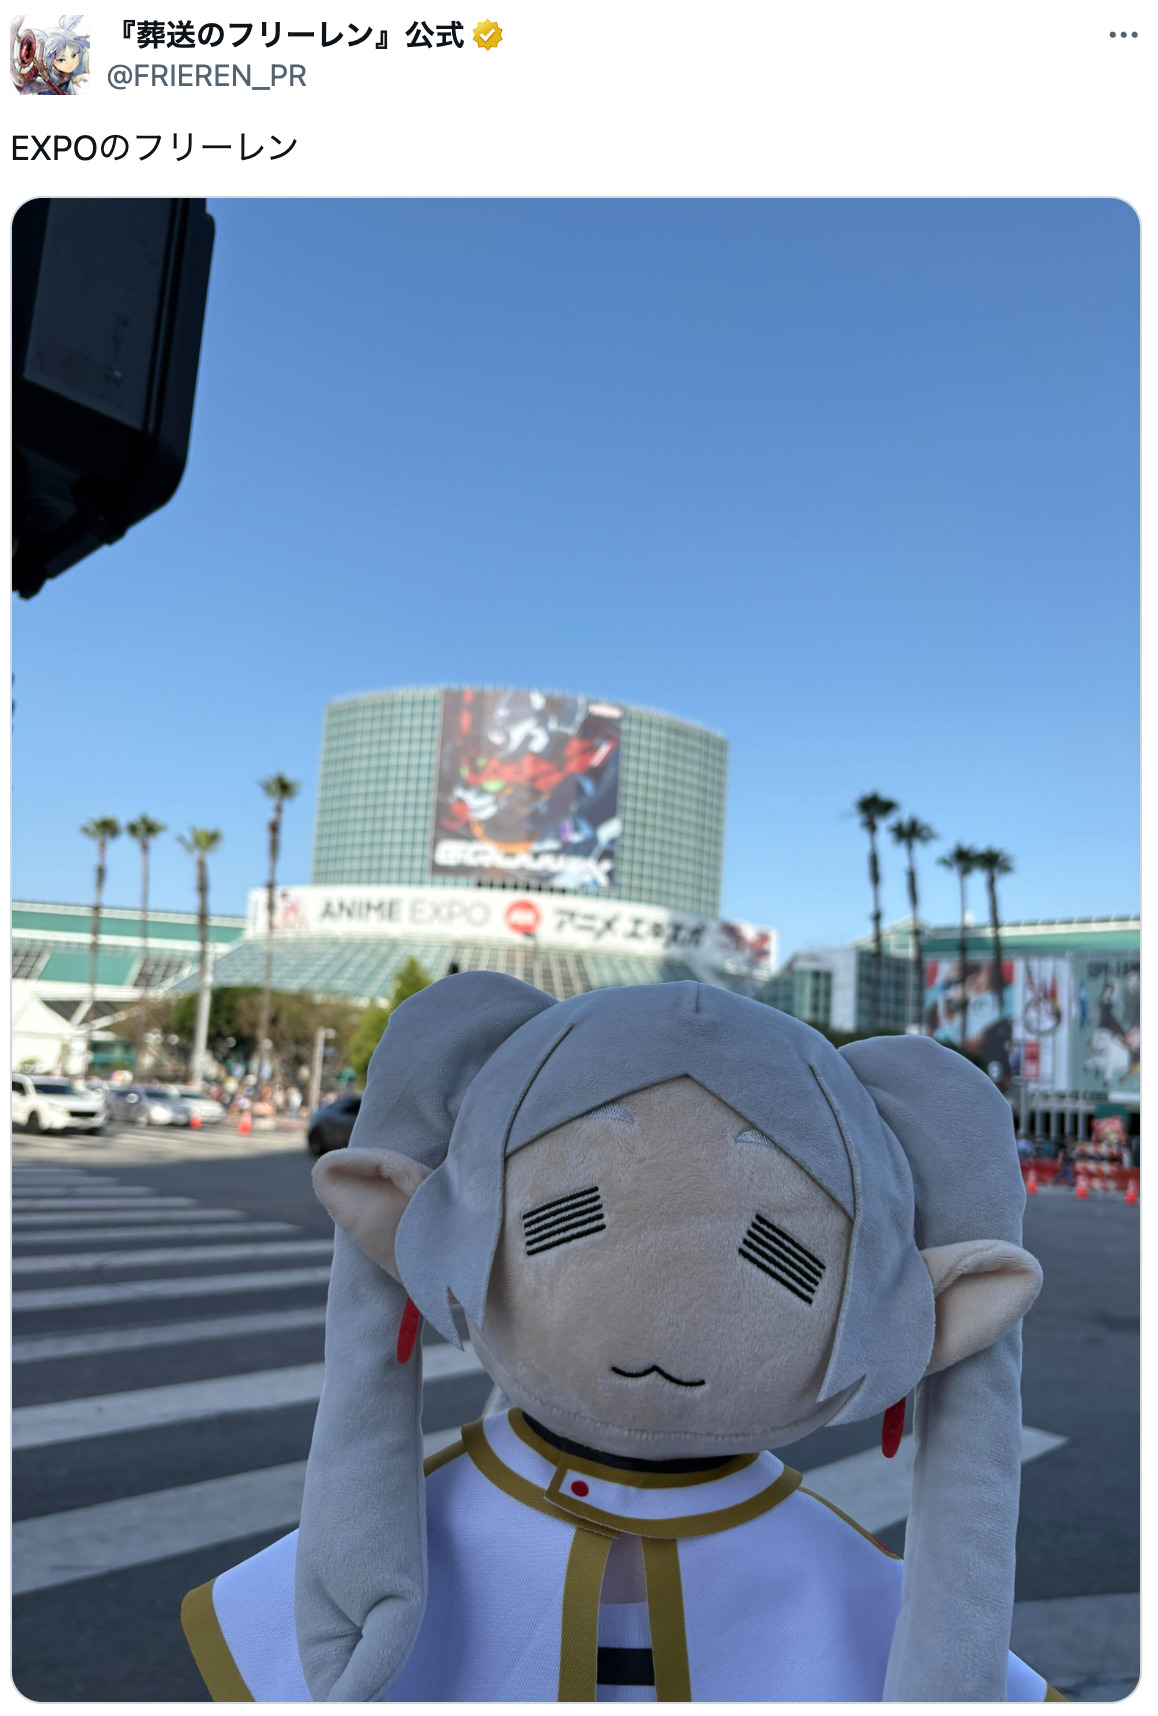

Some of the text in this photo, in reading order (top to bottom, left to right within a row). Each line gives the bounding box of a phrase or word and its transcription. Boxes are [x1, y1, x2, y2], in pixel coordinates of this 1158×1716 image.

[320, 897, 402, 924] ANIME
[408, 898, 492, 927] EXPO
[553, 907, 620, 940] アニメ
